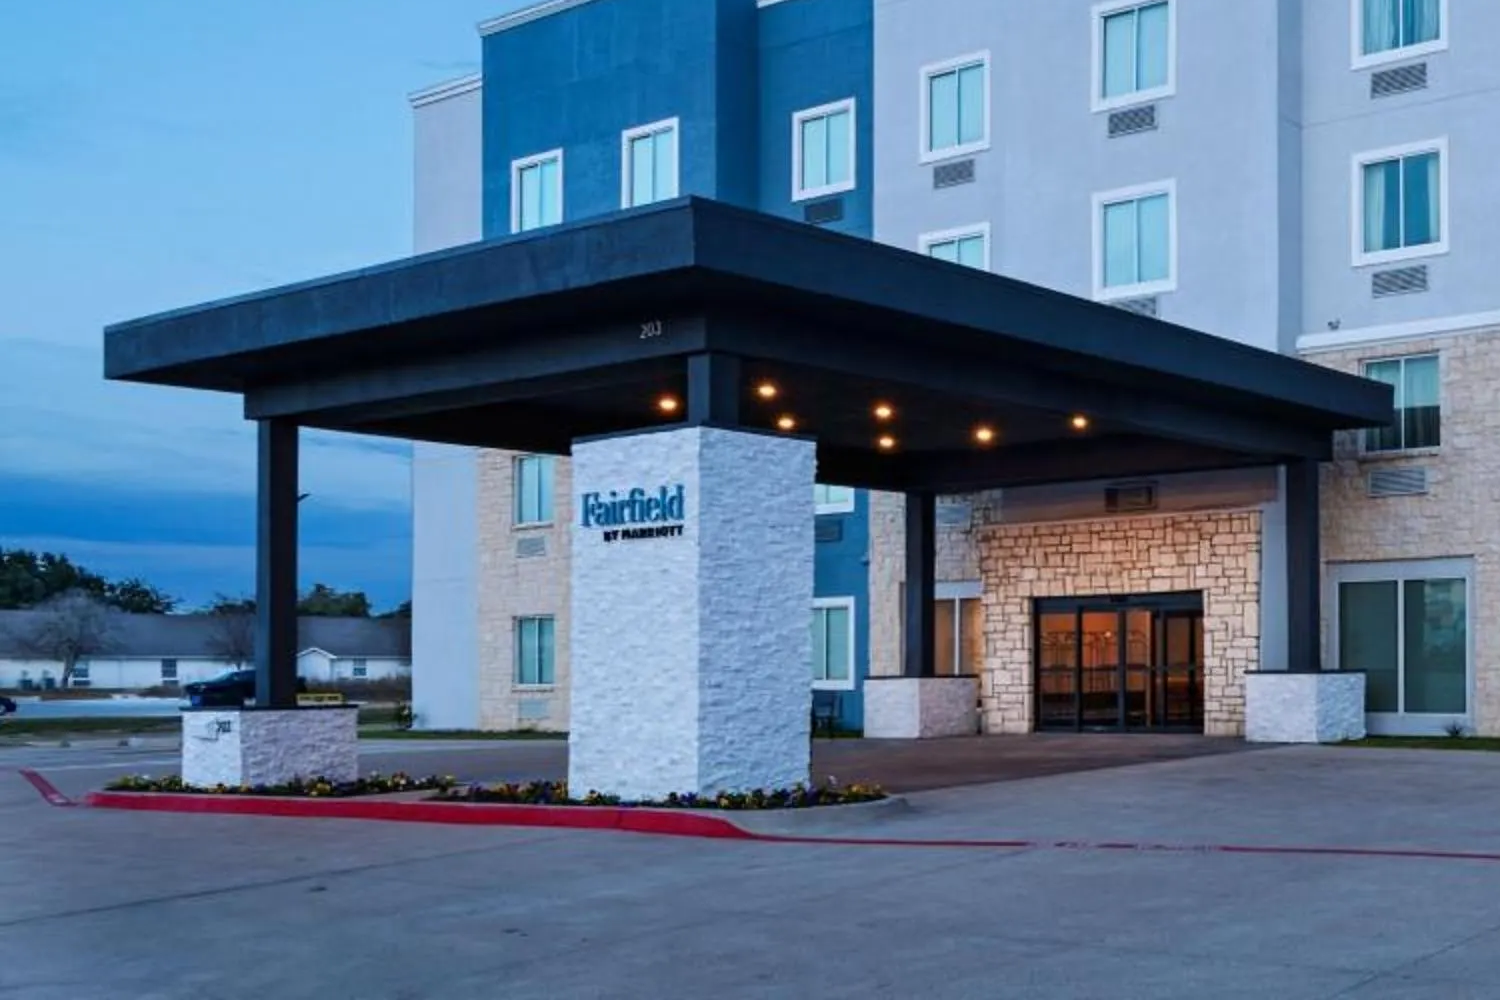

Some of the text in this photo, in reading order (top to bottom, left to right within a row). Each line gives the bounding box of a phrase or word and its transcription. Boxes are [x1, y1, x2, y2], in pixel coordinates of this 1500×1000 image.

[581, 484, 685, 528] Fairfield
[603, 525, 684, 542] BY MARRIOTT
